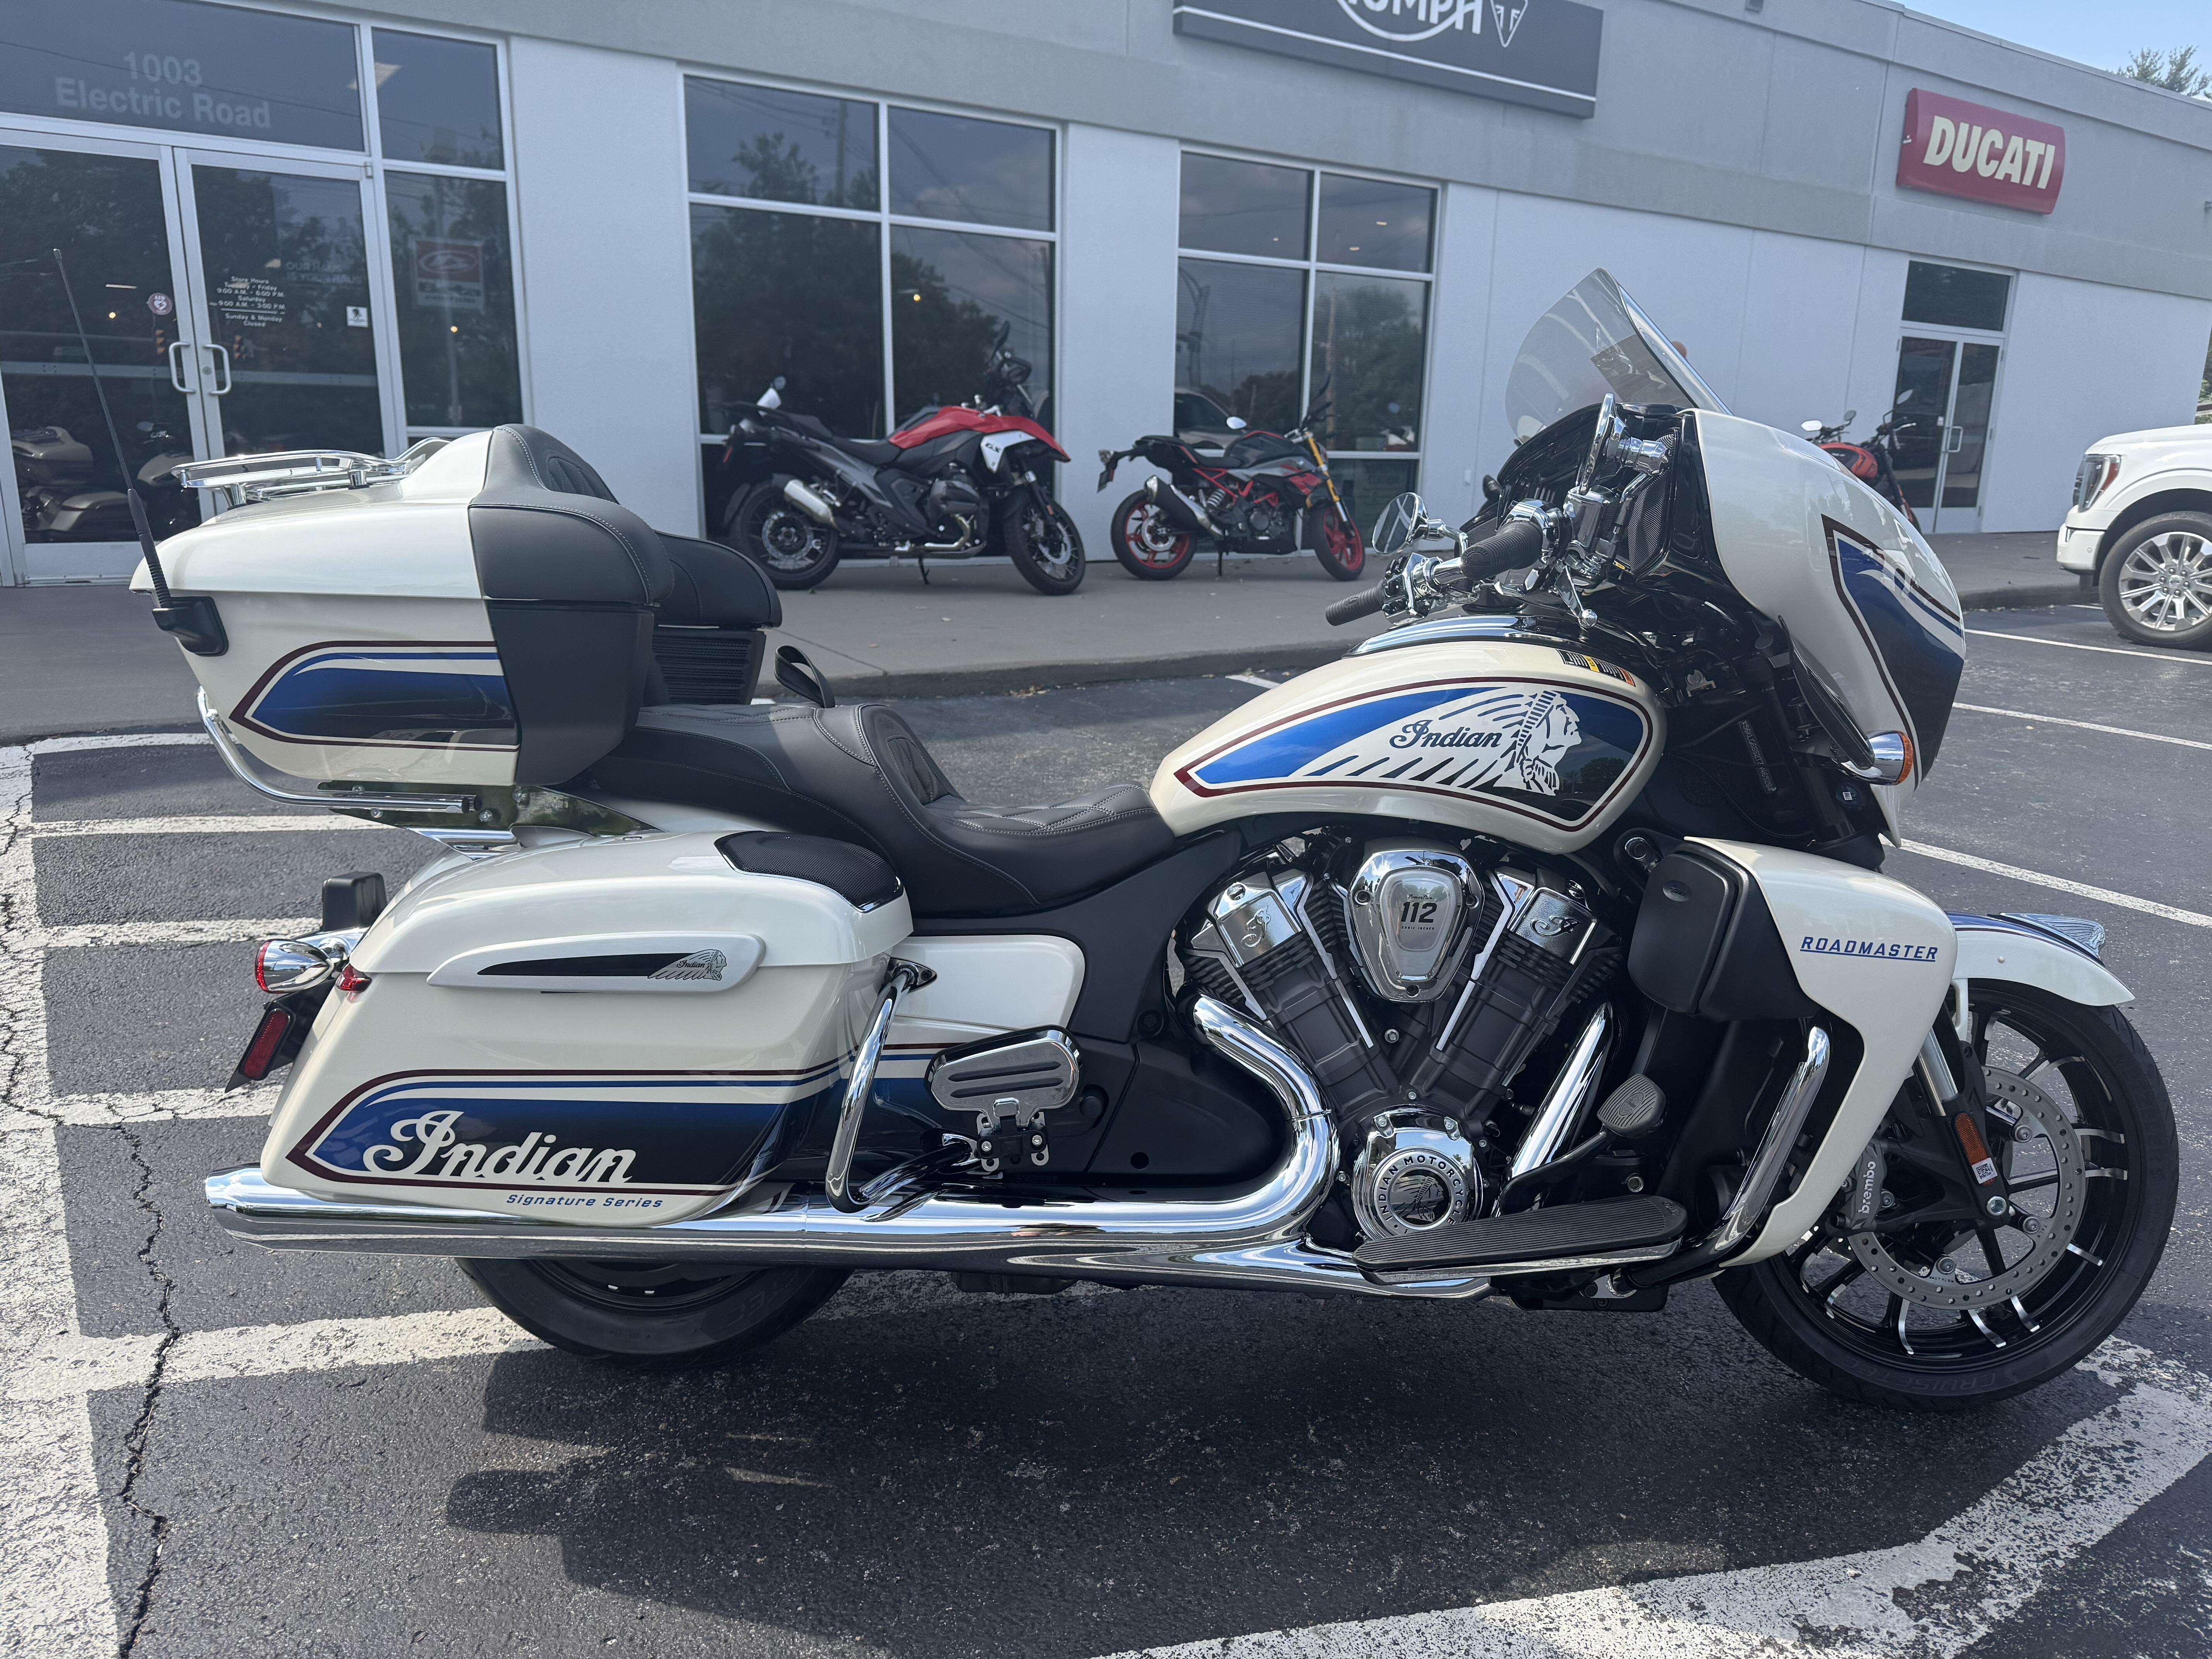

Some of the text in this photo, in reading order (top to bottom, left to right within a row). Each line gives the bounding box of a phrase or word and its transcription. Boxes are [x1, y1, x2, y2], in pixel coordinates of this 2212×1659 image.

[123, 51, 203, 86] 1003
[55, 77, 270, 128] Electric Road
[1923, 115, 2055, 189] DUCATI
[1389, 720, 1503, 749] Indian
[1401, 901, 1438, 923] 112
[677, 959, 705, 968] Indian
[1801, 936, 1938, 960] ROADMASTER
[363, 1110, 636, 1183] Indian
[507, 1194, 663, 1208] Signature Series
[1378, 1154, 1464, 1225] INDIAN MOTORCYCLE
[1858, 1161, 1876, 1214] brembo
